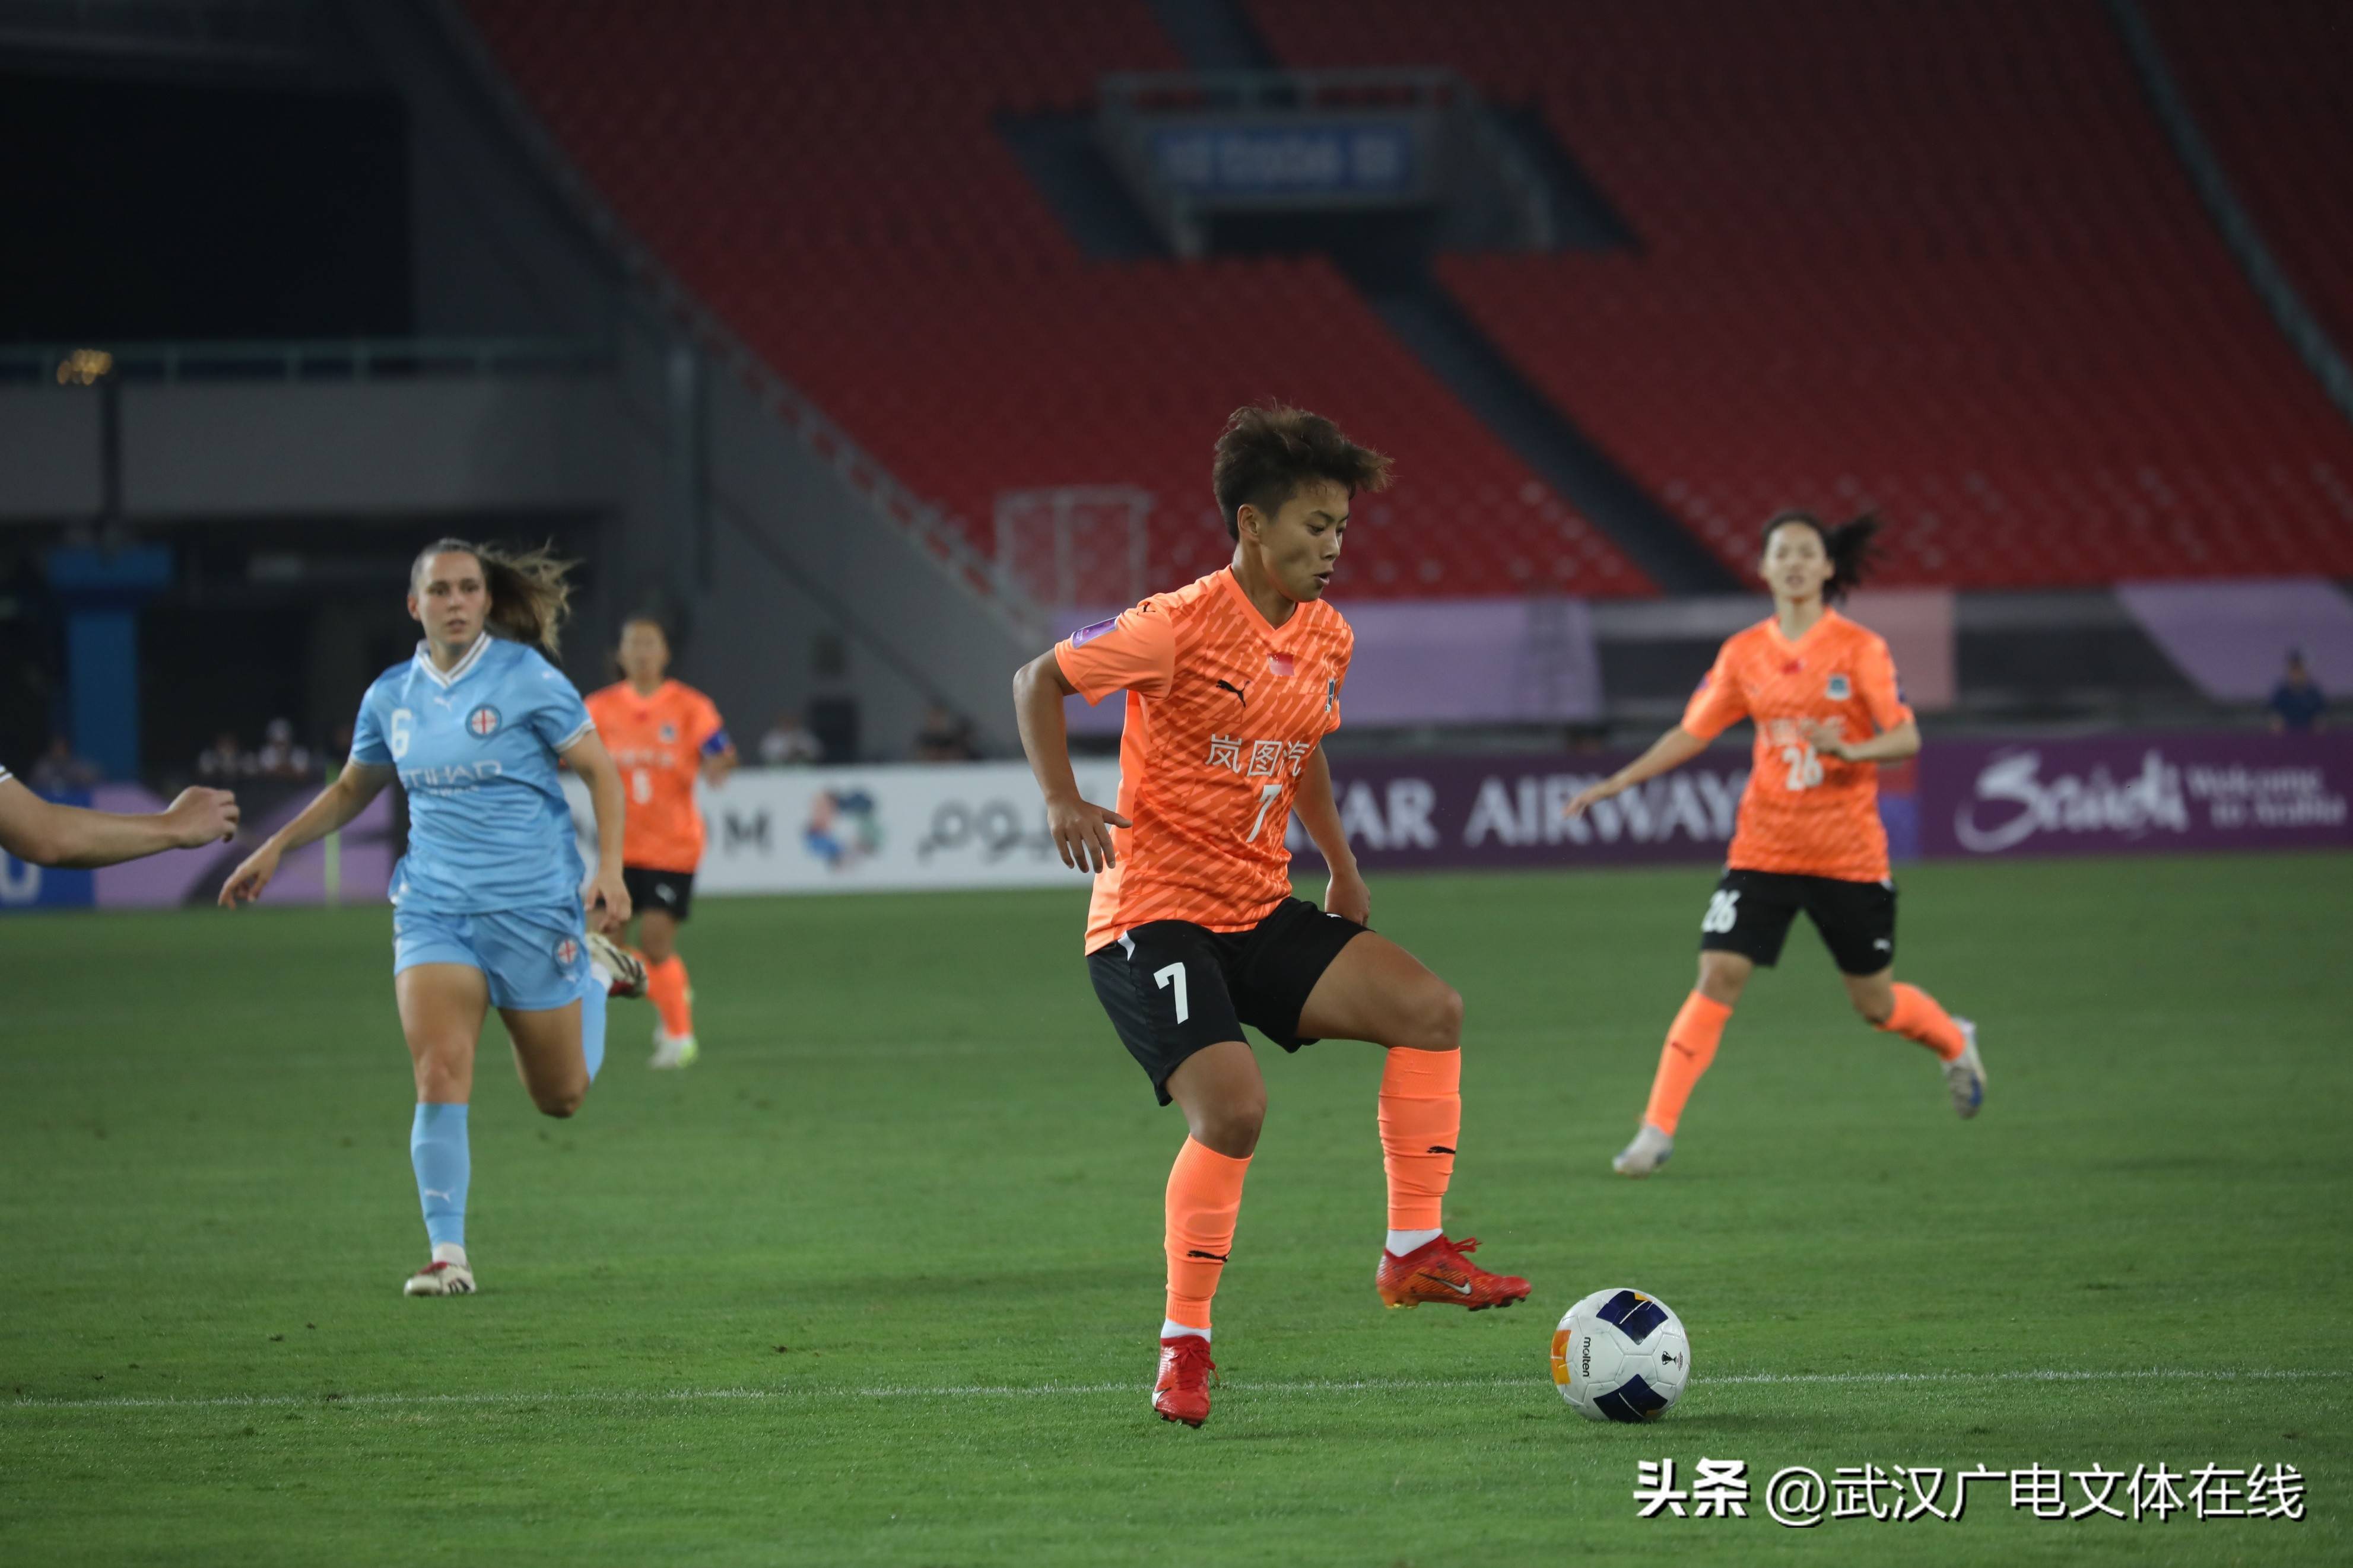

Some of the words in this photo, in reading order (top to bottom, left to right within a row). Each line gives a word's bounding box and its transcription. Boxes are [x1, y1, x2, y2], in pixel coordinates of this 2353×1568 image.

[391, 708, 412, 758] 6
[1205, 734, 1310, 777] 岚图汽
[1783, 746, 1824, 791] 26
[1246, 784, 1282, 842] 7
[1701, 890, 1741, 933] 26
[1153, 962, 1189, 1025] 7
[1582, 1337, 1591, 1378] molten
